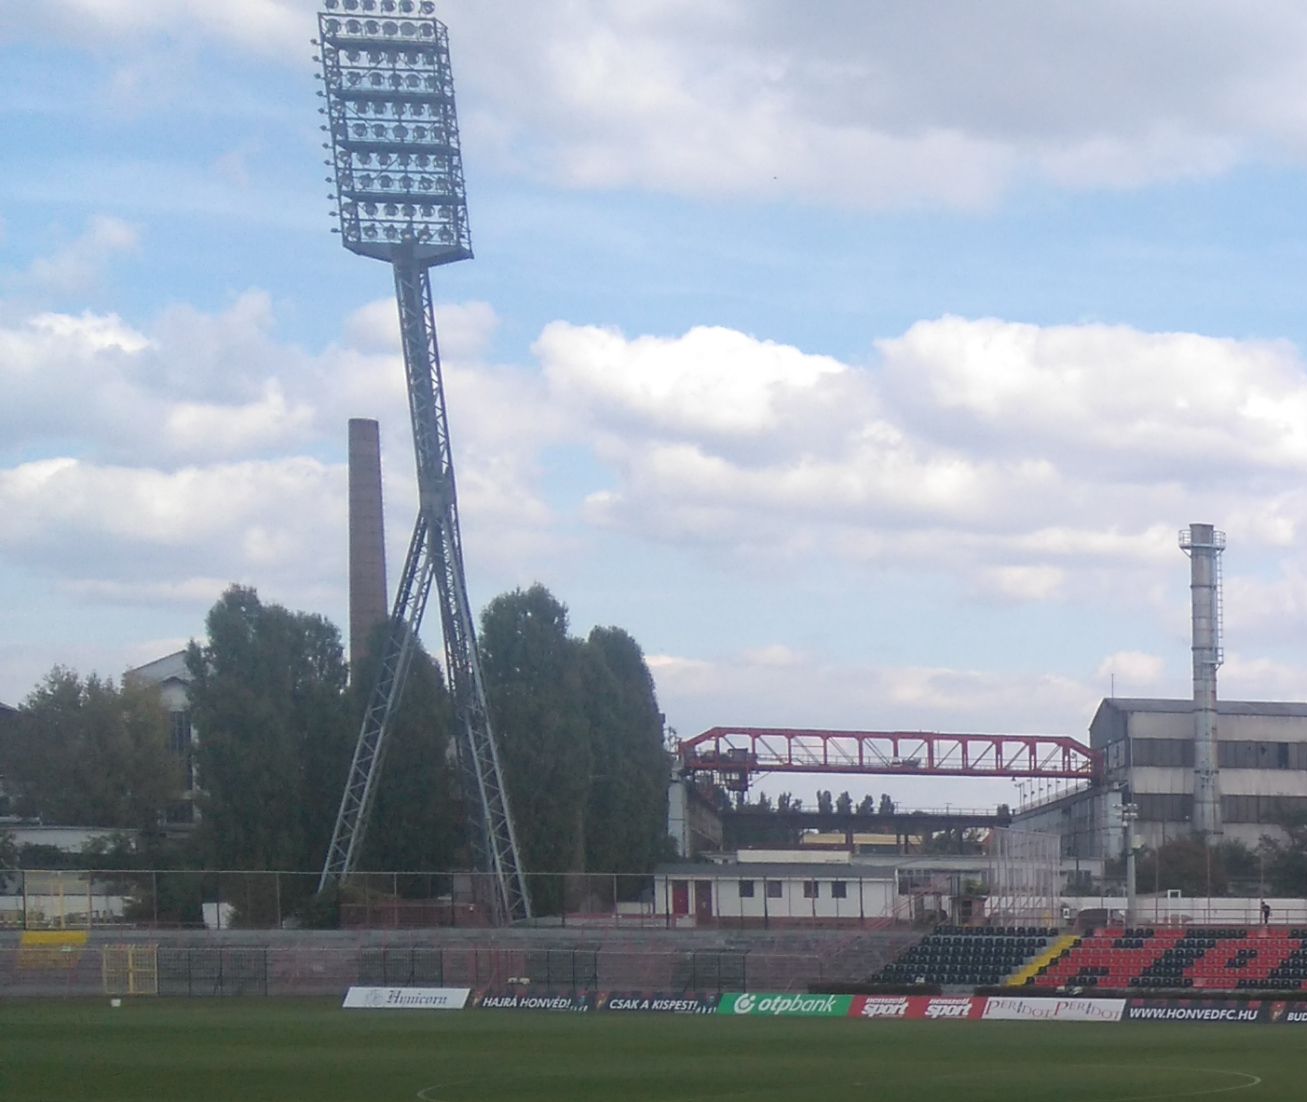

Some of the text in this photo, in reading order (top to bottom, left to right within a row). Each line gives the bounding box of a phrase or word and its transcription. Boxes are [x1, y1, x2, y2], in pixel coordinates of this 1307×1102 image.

[386, 989, 448, 1005] Hunicorn
[483, 995, 571, 1009] HAJRÁ HONVÉD!
[758, 994, 836, 1014] otpbank
[609, 999, 697, 1011] CSAK A KISPEST!
[861, 1002, 908, 1017] sport
[925, 1003, 972, 1018] sport
[1129, 1008, 1258, 1021] WWW.HONVEDFC.HU
